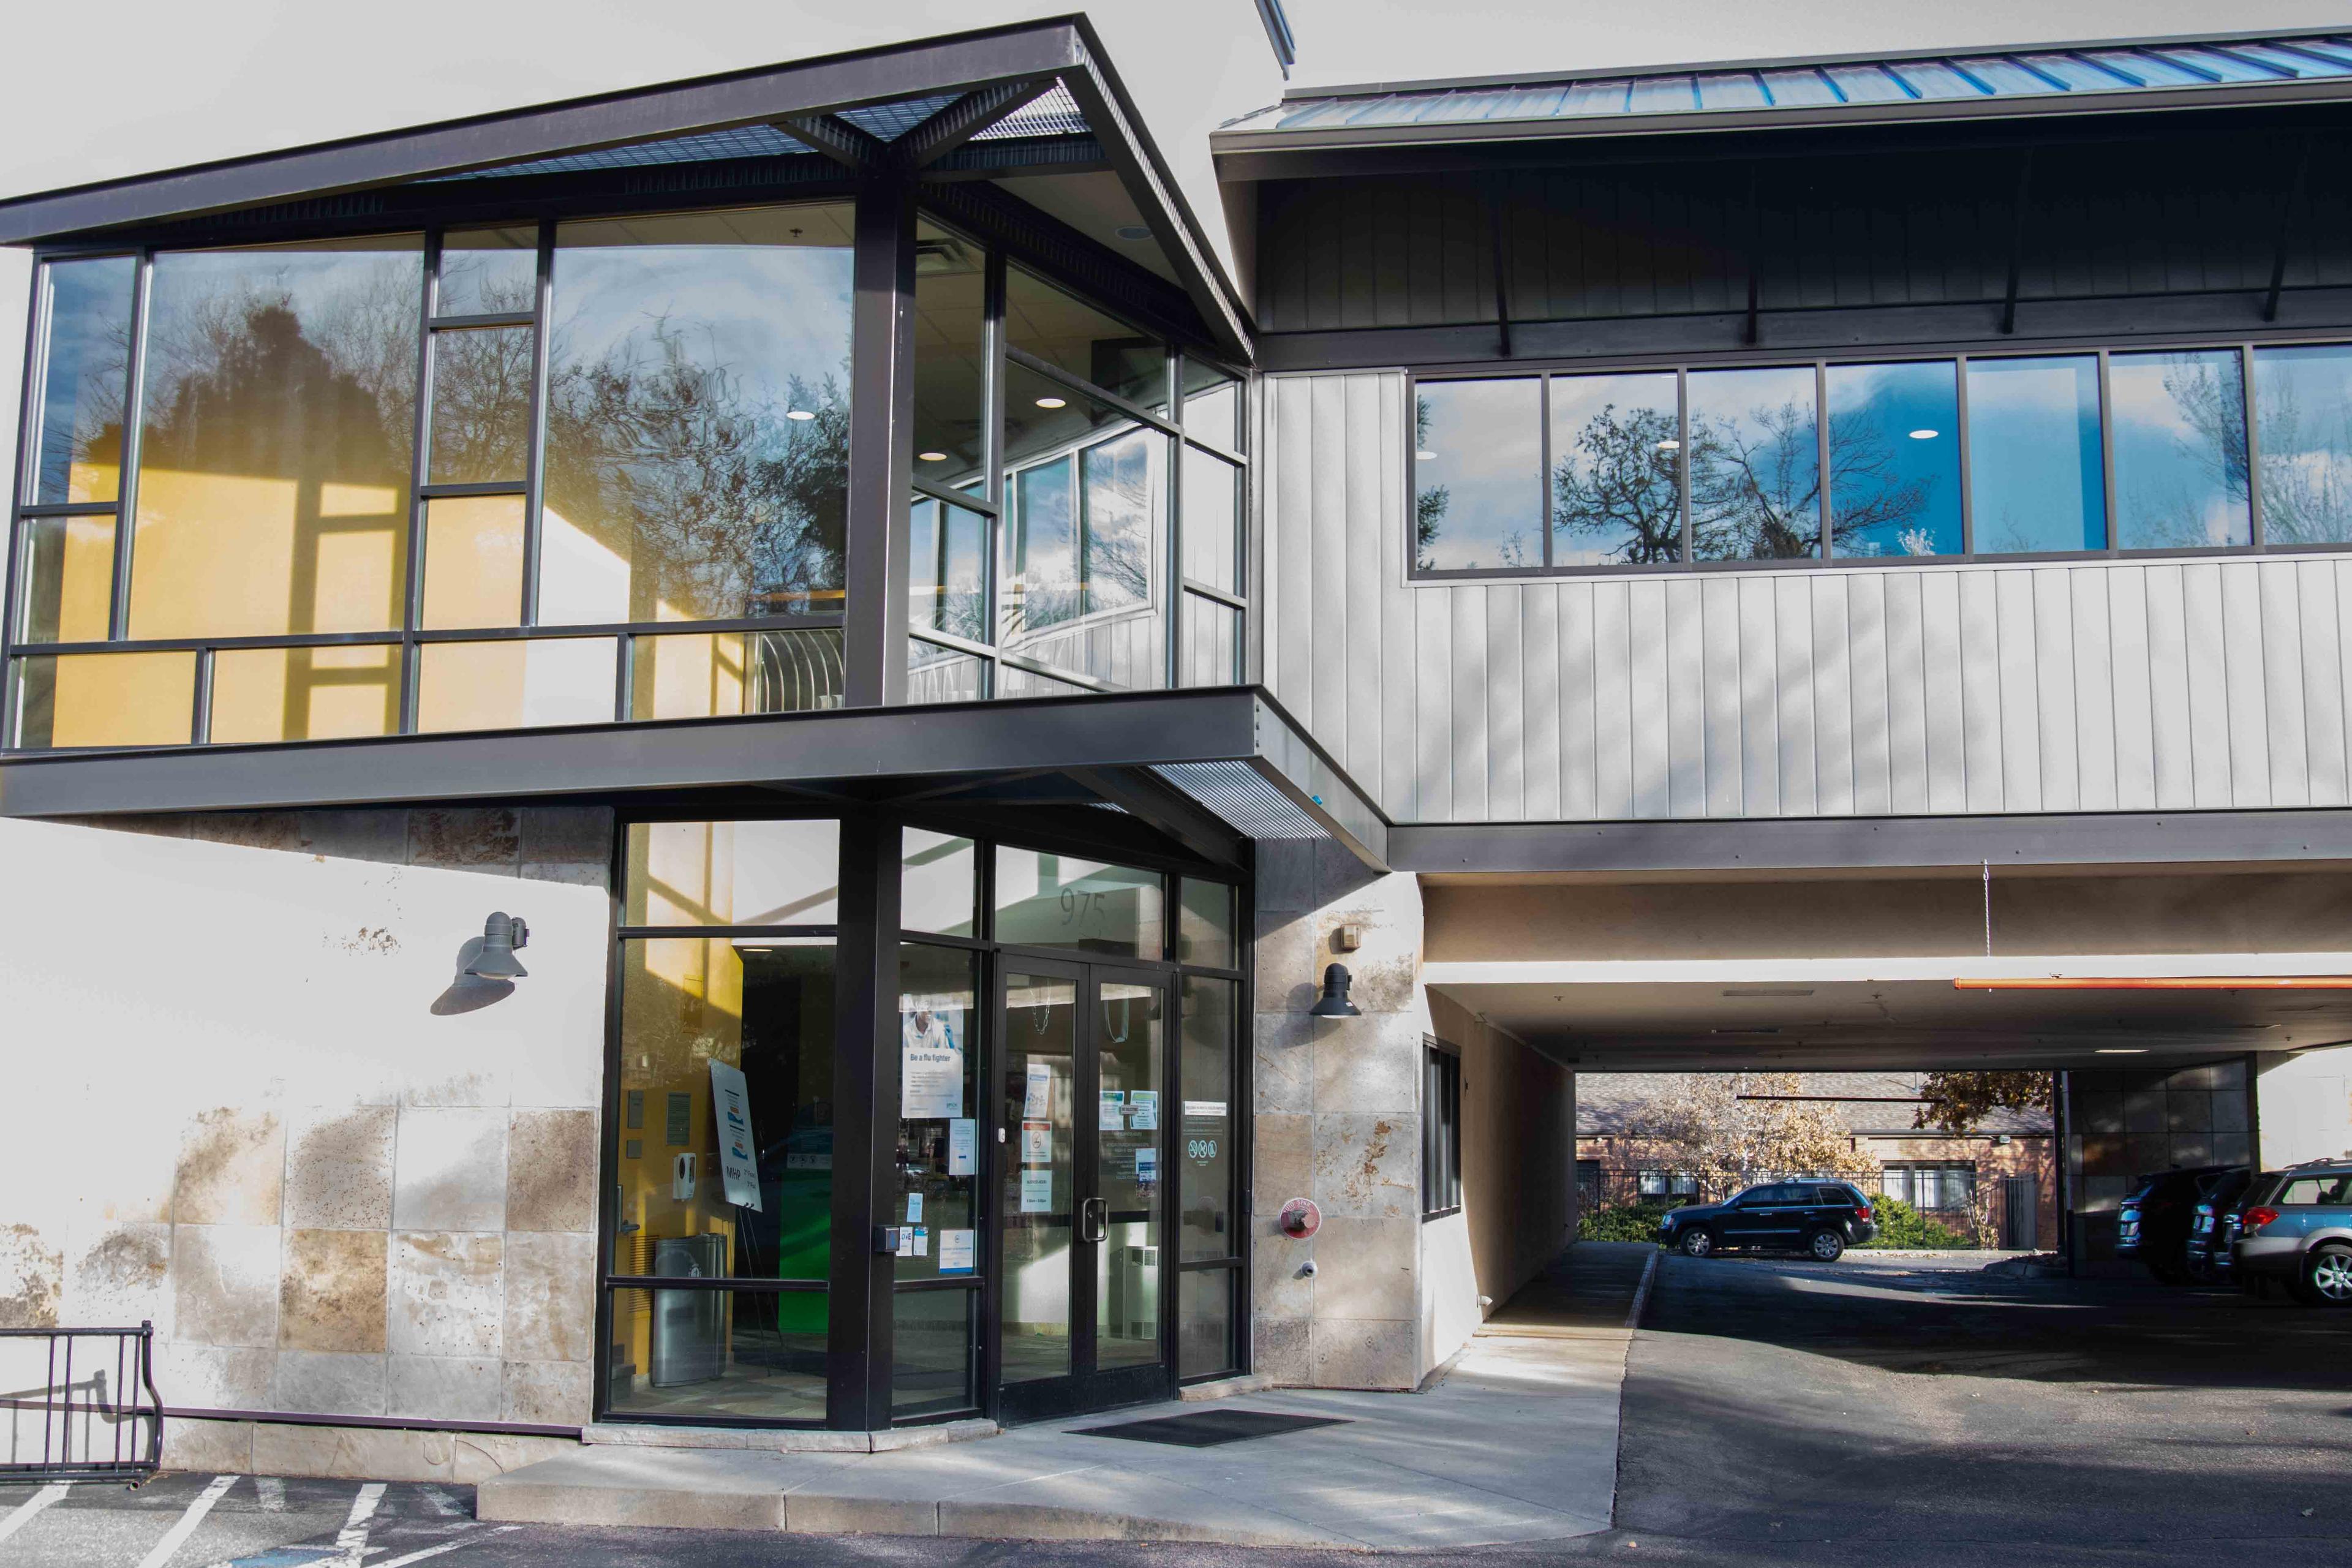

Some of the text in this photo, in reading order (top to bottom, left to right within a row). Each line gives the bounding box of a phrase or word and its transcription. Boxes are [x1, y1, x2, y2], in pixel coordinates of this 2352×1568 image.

[1060, 888, 1106, 927] 975
[932, 1054, 951, 1063] fighter
[726, 1166, 741, 1180] MHP
